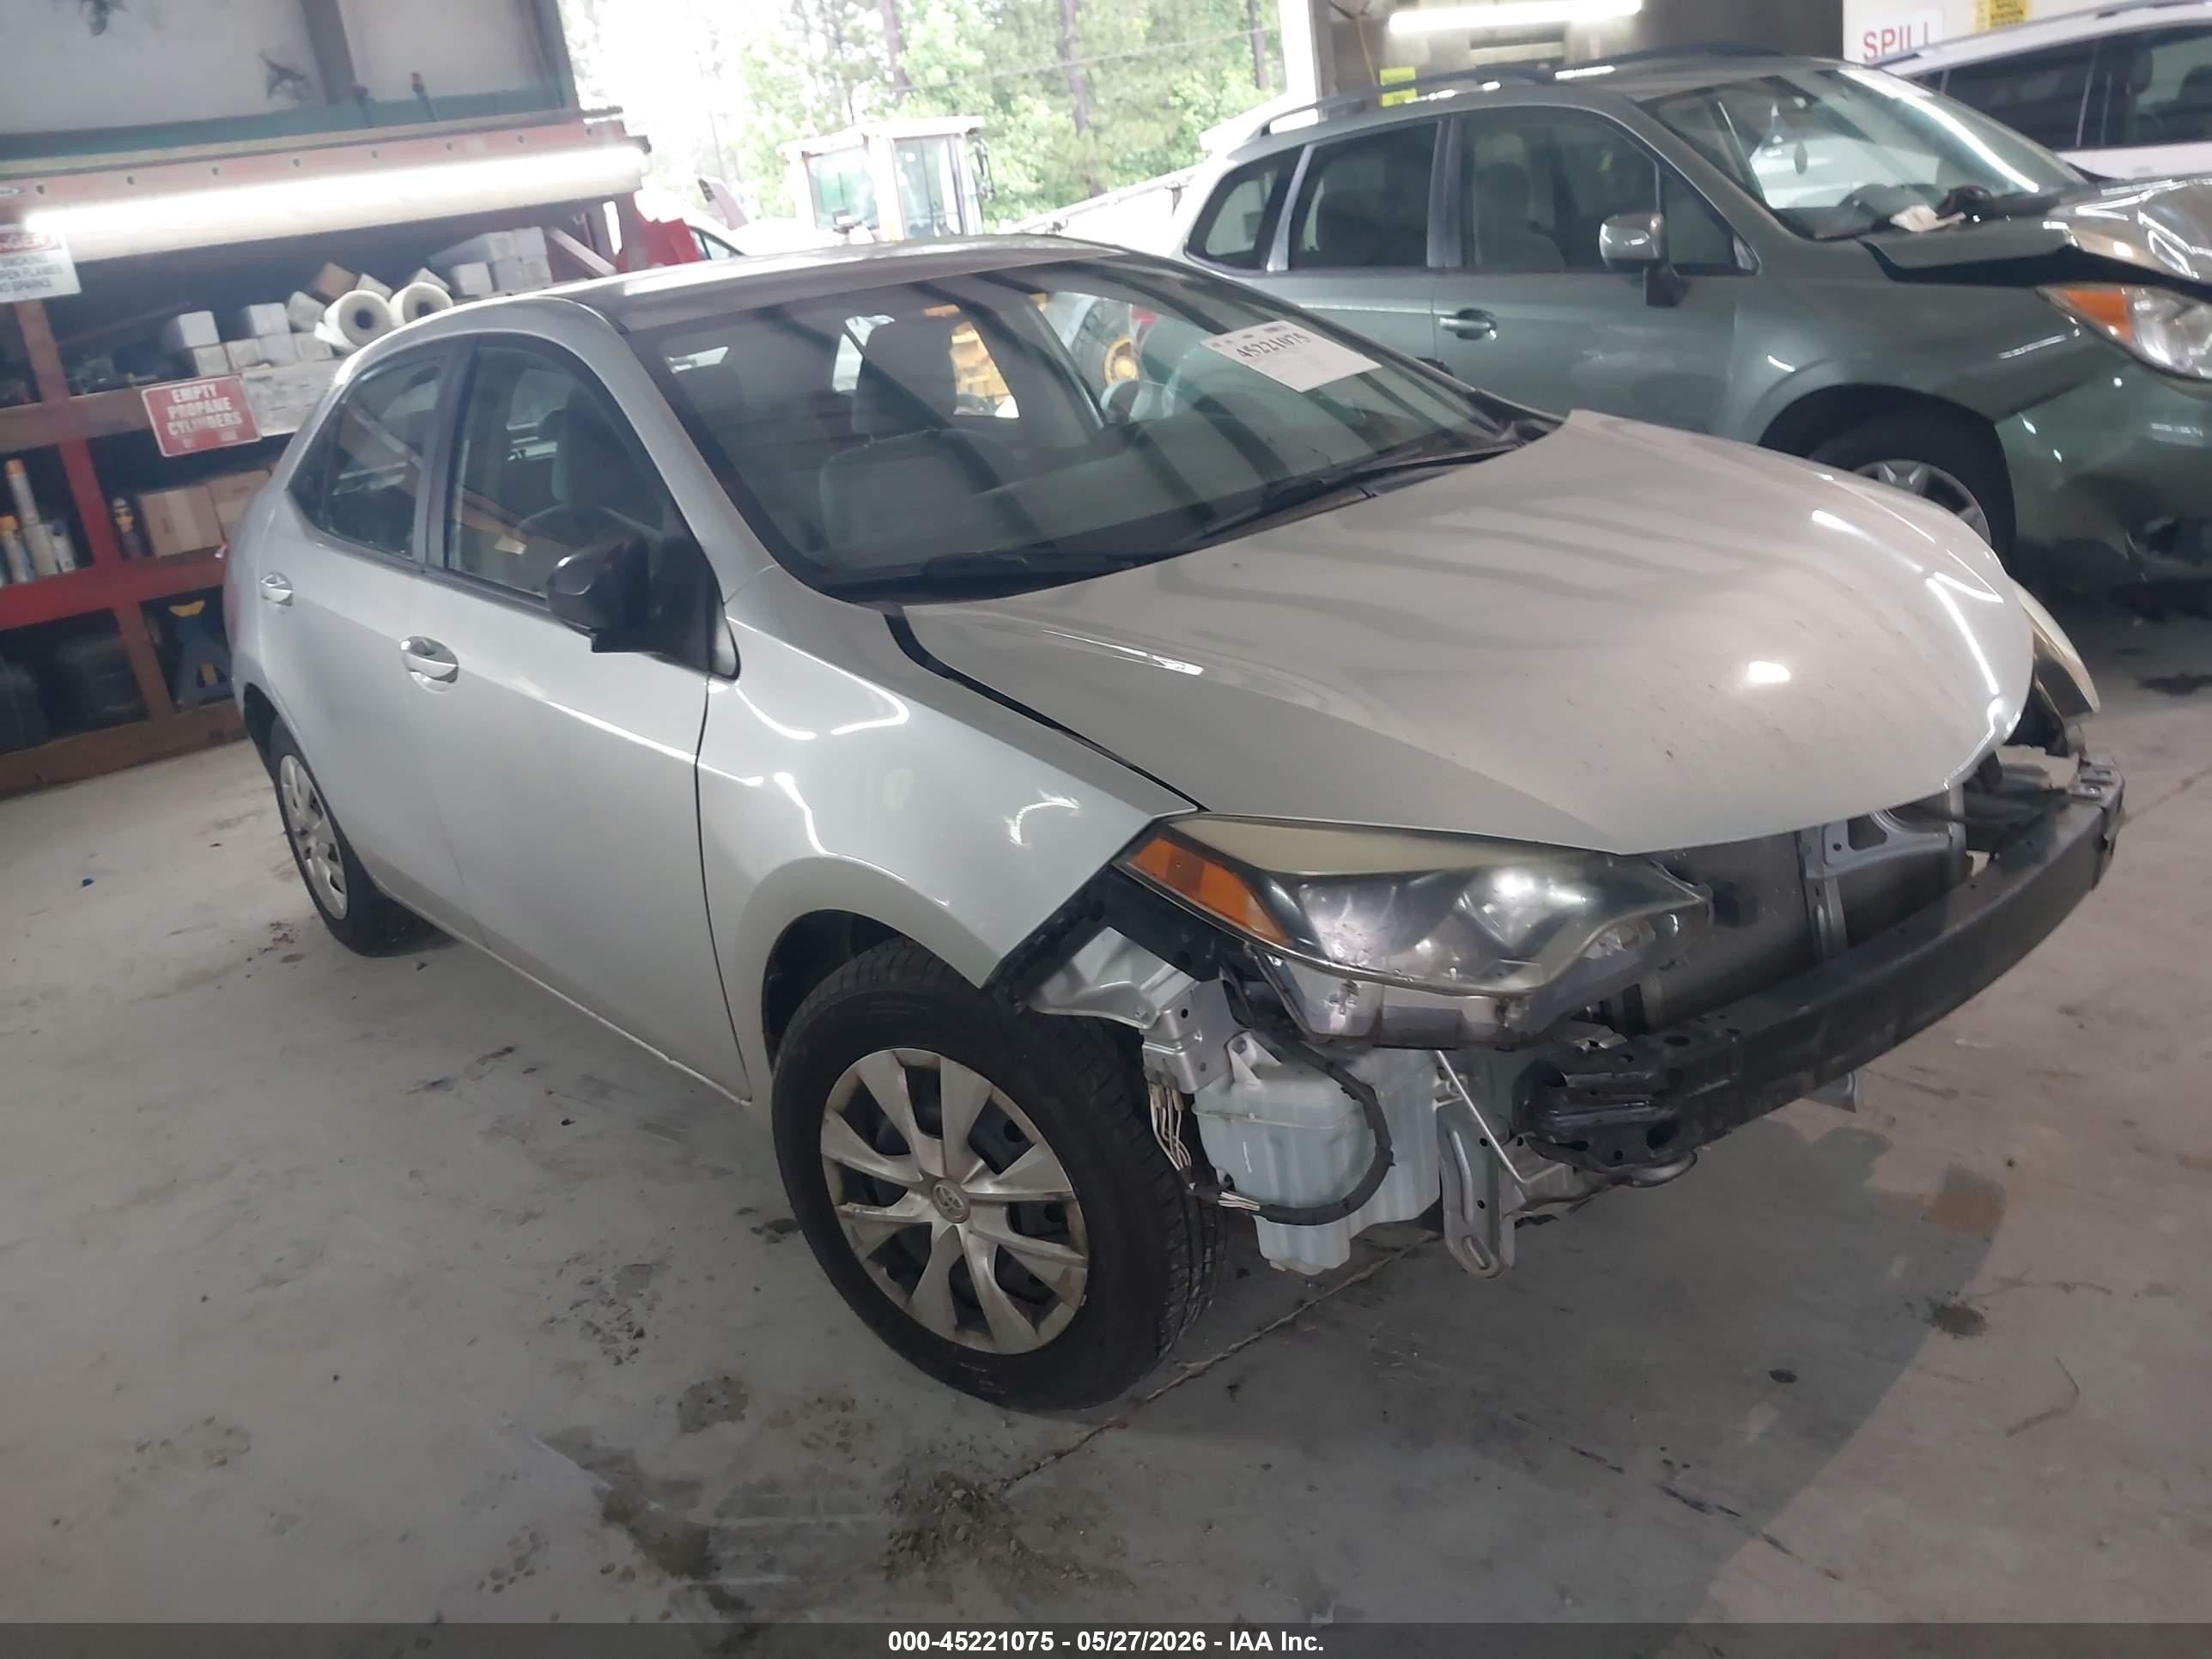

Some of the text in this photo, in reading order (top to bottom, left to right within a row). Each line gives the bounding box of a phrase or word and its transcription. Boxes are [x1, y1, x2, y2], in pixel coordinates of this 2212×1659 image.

[1236, 331, 1311, 358] 45221075
[172, 384, 217, 404] EMPTY
[167, 397, 233, 420] PROPANE
[167, 411, 243, 436] CYLINDERS
